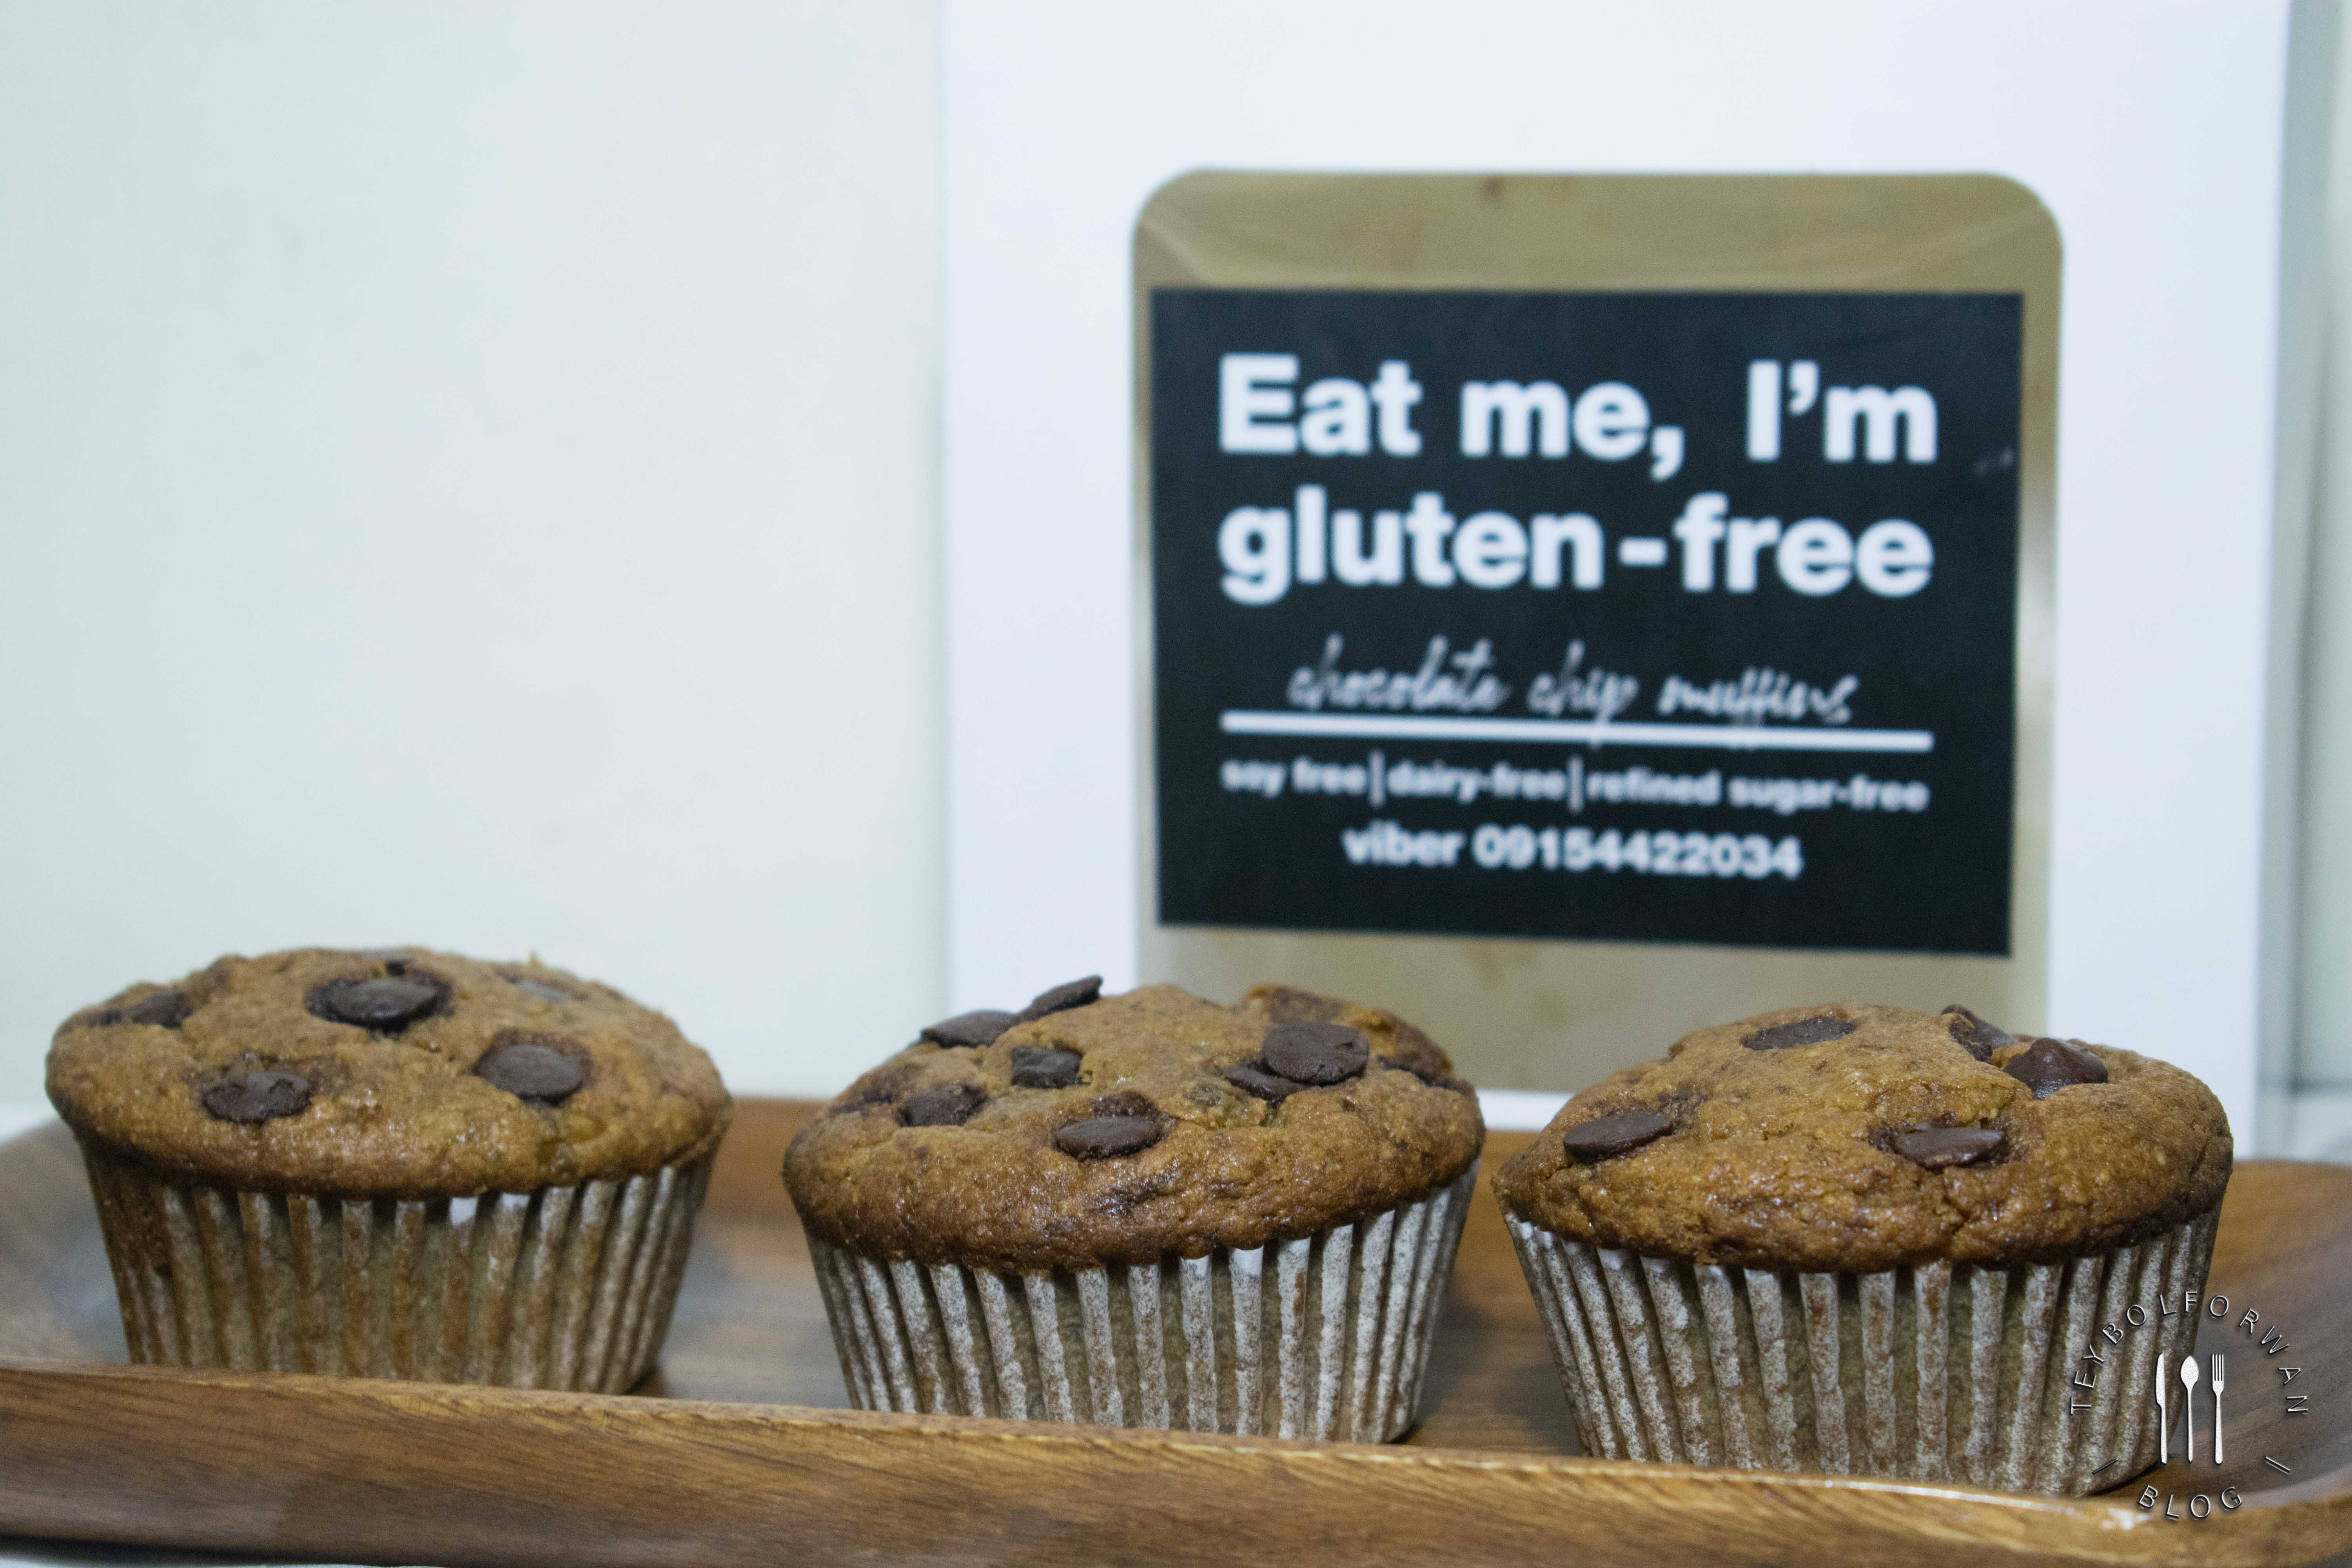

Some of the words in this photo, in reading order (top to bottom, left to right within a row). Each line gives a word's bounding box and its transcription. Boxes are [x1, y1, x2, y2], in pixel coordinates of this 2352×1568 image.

[1217, 351, 1424, 459] Eat
[1458, 379, 1685, 482] me,
[1744, 358, 1938, 465] I’m
[1216, 482, 1935, 607] gluten-free
[1287, 634, 1511, 710] chocolate
[1527, 641, 1639, 748] chip
[1657, 666, 1858, 739] muffins
[1341, 820, 1466, 867] viber
[1471, 823, 1804, 879] 09154422034
[1727, 773, 1930, 815] sugar-free
